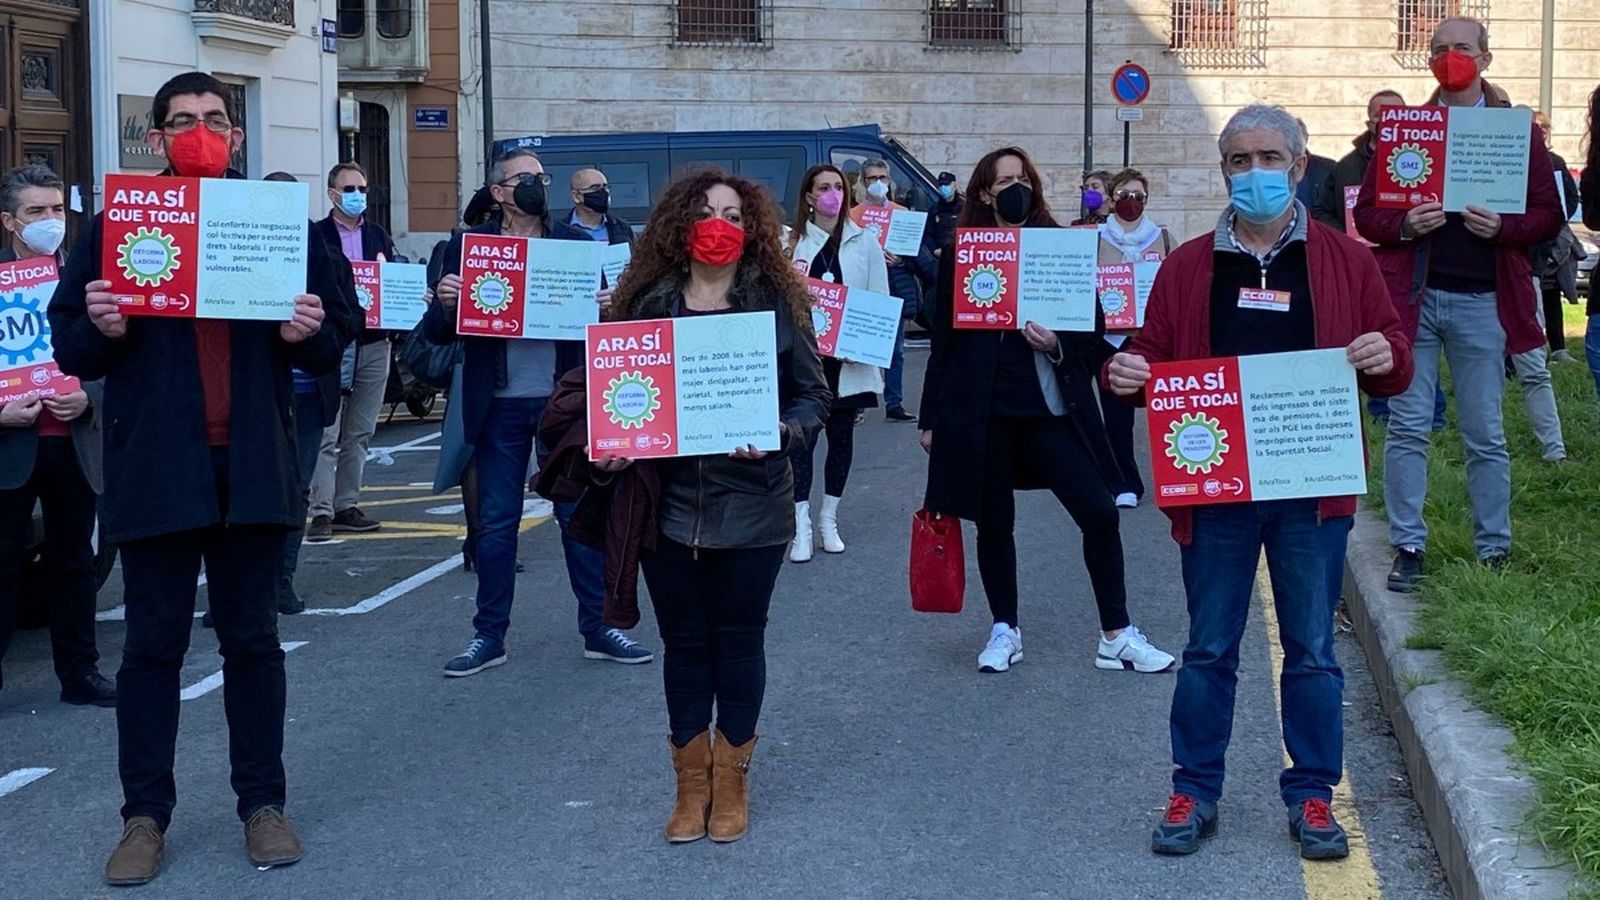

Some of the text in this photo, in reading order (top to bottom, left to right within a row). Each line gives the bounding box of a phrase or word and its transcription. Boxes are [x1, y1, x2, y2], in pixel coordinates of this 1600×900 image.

[1382, 109, 1443, 122] ¡AHORA
[1381, 124, 1444, 142] SÍ TOCA!
[112, 185, 187, 208] ARA SÍ
[108, 208, 195, 224] QUE TOCA!
[260, 223, 300, 231] negociació
[958, 232, 1015, 245] ¡AHORA
[470, 244, 518, 259] ARA SÍ
[958, 245, 1016, 263] SÍ TOCA!
[206, 264, 254, 272] vulnerables.
[364, 266, 374, 276] SÍ
[466, 258, 524, 271] QUE TOCA!
[1, 264, 54, 285] SÍ TOCA!
[828, 288, 841, 300] SÍ
[820, 298, 843, 310] TOCA!
[597, 328, 661, 352] ARA SÍ
[594, 353, 671, 369] QUE TOCA!
[746, 363, 768, 371] portat
[708, 376, 750, 385] desigualtat,
[1153, 366, 1225, 393] ARA SÍ
[717, 387, 763, 396] temporalitat
[1250, 391, 1294, 400] Reclamem
[1321, 386, 1350, 395] millora
[1151, 392, 1238, 411] QUE TOCA!
[1271, 402, 1309, 411] ingressos
[1315, 421, 1353, 430] despeses
[1298, 435, 1313, 443] que
[1315, 432, 1354, 441] assumeix
[1265, 446, 1305, 457] Seguretat
[1307, 445, 1333, 453] Social.
